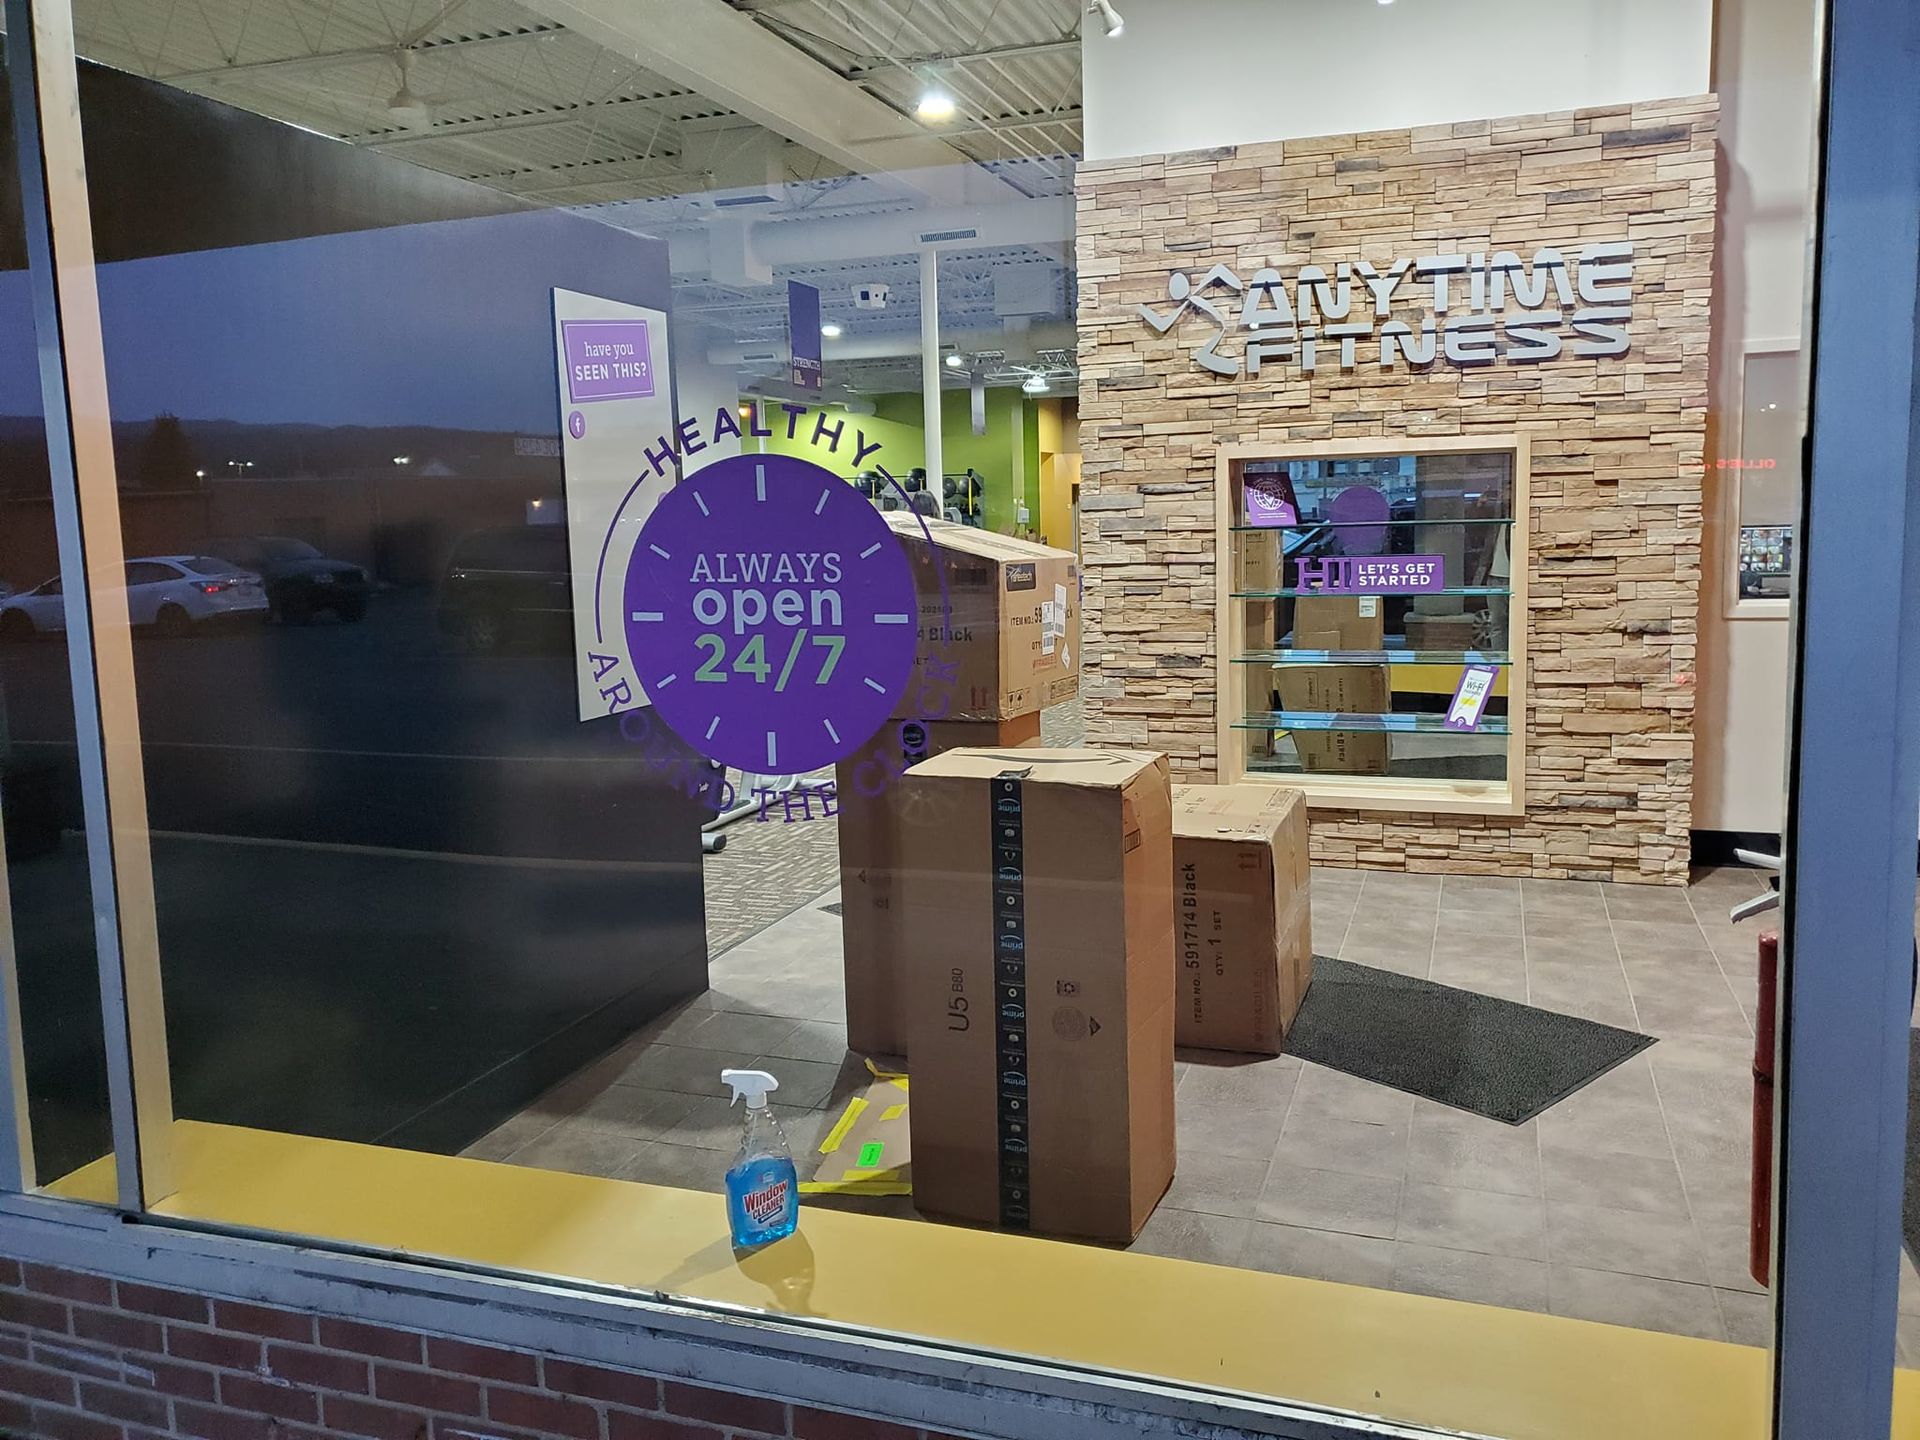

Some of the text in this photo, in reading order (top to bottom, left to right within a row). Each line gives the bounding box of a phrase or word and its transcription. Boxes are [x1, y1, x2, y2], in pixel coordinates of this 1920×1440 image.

[1240, 241, 1634, 326] ANYTIME
[584, 341, 635, 361] have you
[1246, 306, 1634, 375] FITNESS
[575, 362, 648, 381] SEEN THIS?
[643, 402, 883, 478] HEALTHY
[689, 552, 843, 583] ALWAYS
[1358, 562, 1436, 575] LET'S GET
[1358, 574, 1431, 586] STARTED
[692, 587, 843, 635] open
[694, 628, 847, 692] 24/7
[750, 780, 846, 824] THE
[852, 651, 961, 798] CLOCK
[1181, 863, 1197, 908] Black
[1213, 910, 1222, 931] SET
[1183, 912, 1200, 969] 591714
[1214, 951, 1223, 976] QTY:
[948, 996, 969, 1033] U5
[1194, 997, 1203, 1024] ITEM
[743, 1179, 789, 1213] Window
[752, 1194, 785, 1220] CLEANER
